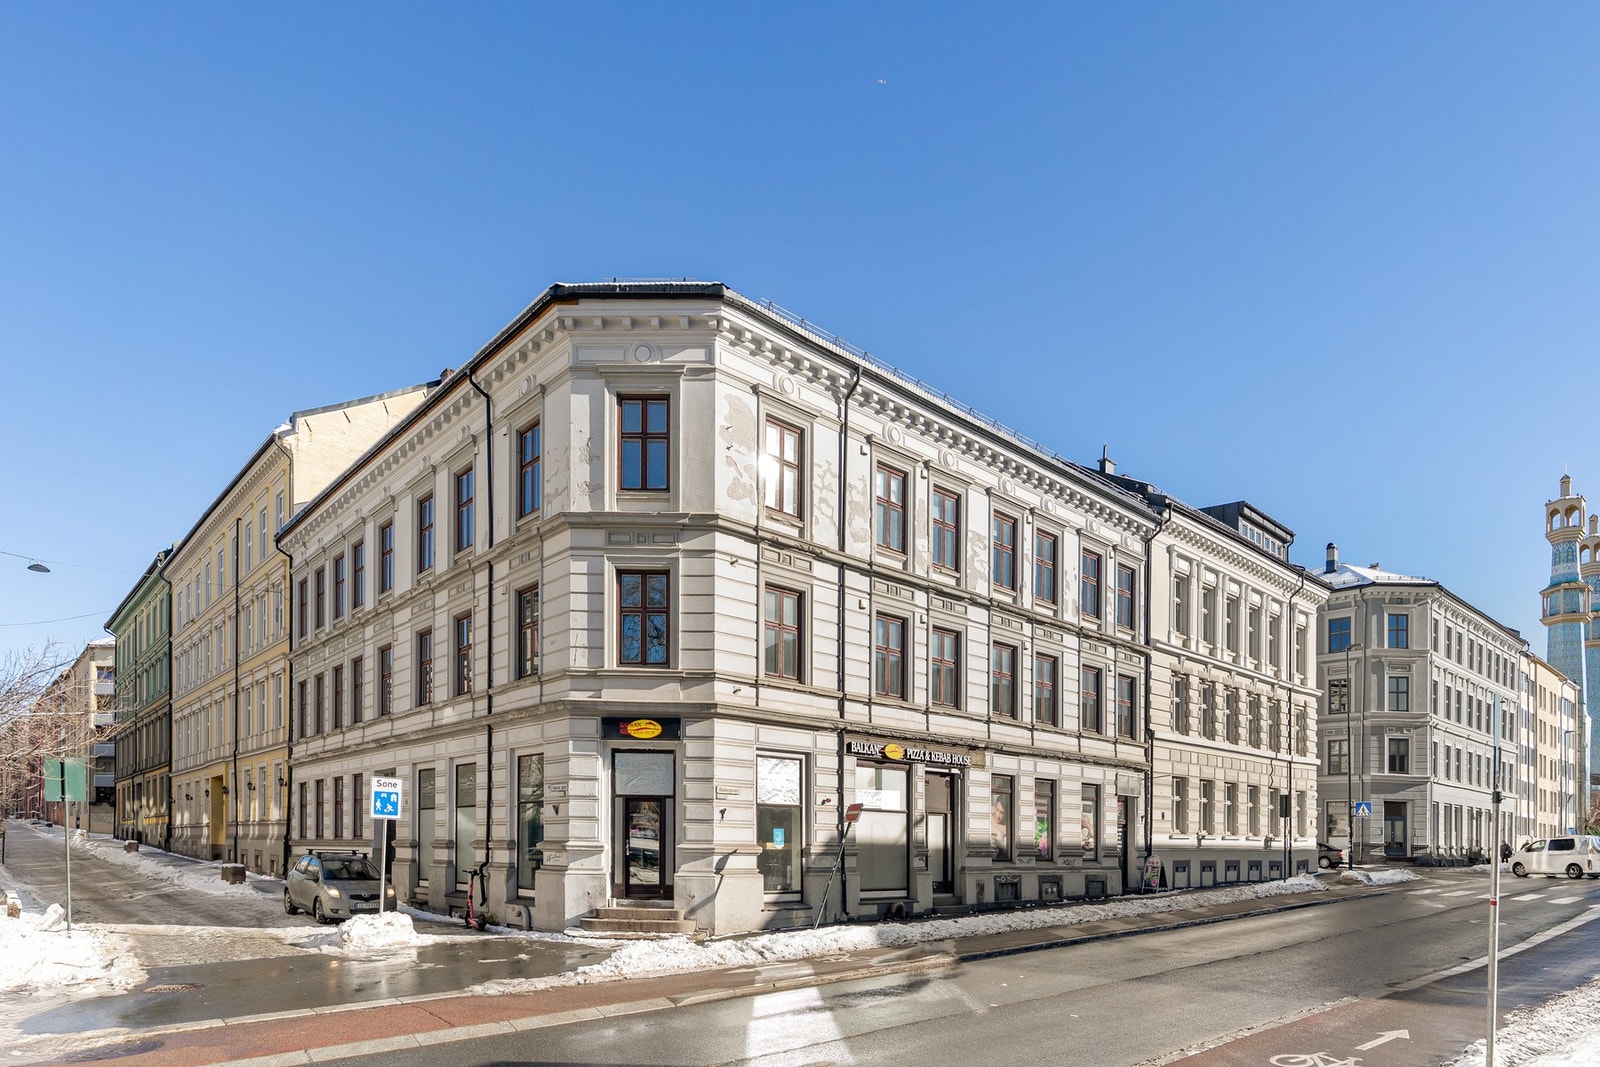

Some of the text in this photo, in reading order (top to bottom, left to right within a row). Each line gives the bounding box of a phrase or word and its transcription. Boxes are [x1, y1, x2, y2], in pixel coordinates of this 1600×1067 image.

[851, 741, 972, 766] BALKAN PIZZA & KEBAB HOUSE
[376, 779, 398, 789] Sone
